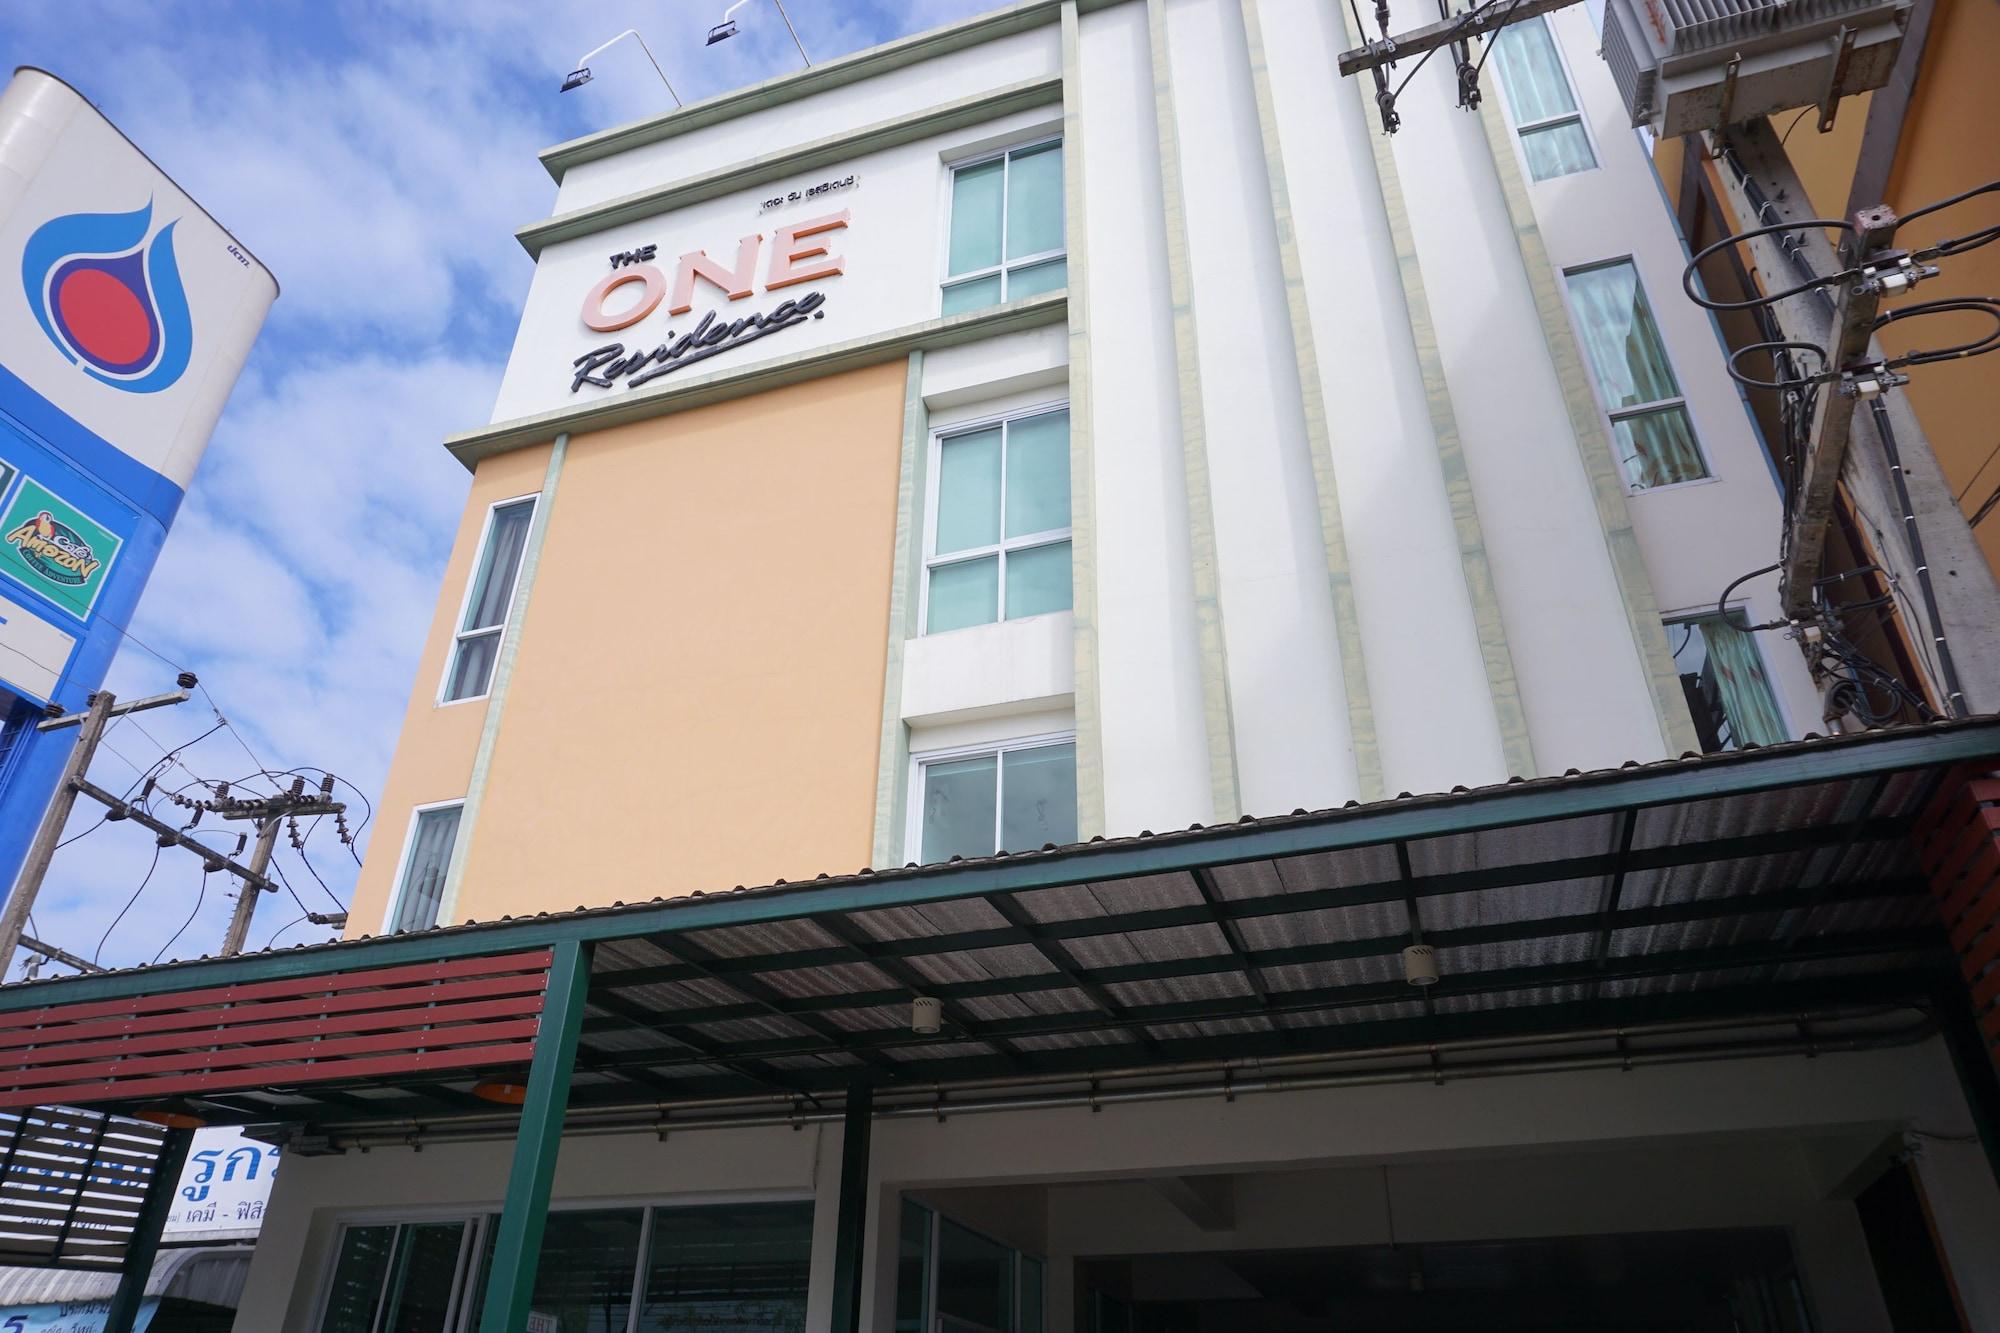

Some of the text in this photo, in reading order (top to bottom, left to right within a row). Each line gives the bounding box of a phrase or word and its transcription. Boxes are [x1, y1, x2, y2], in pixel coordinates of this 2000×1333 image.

[580, 207, 852, 333] ONE
[609, 243, 658, 270] THE
[186, 1202, 217, 1223] เคมี
[237, 1200, 266, 1220] ฟิสิ
